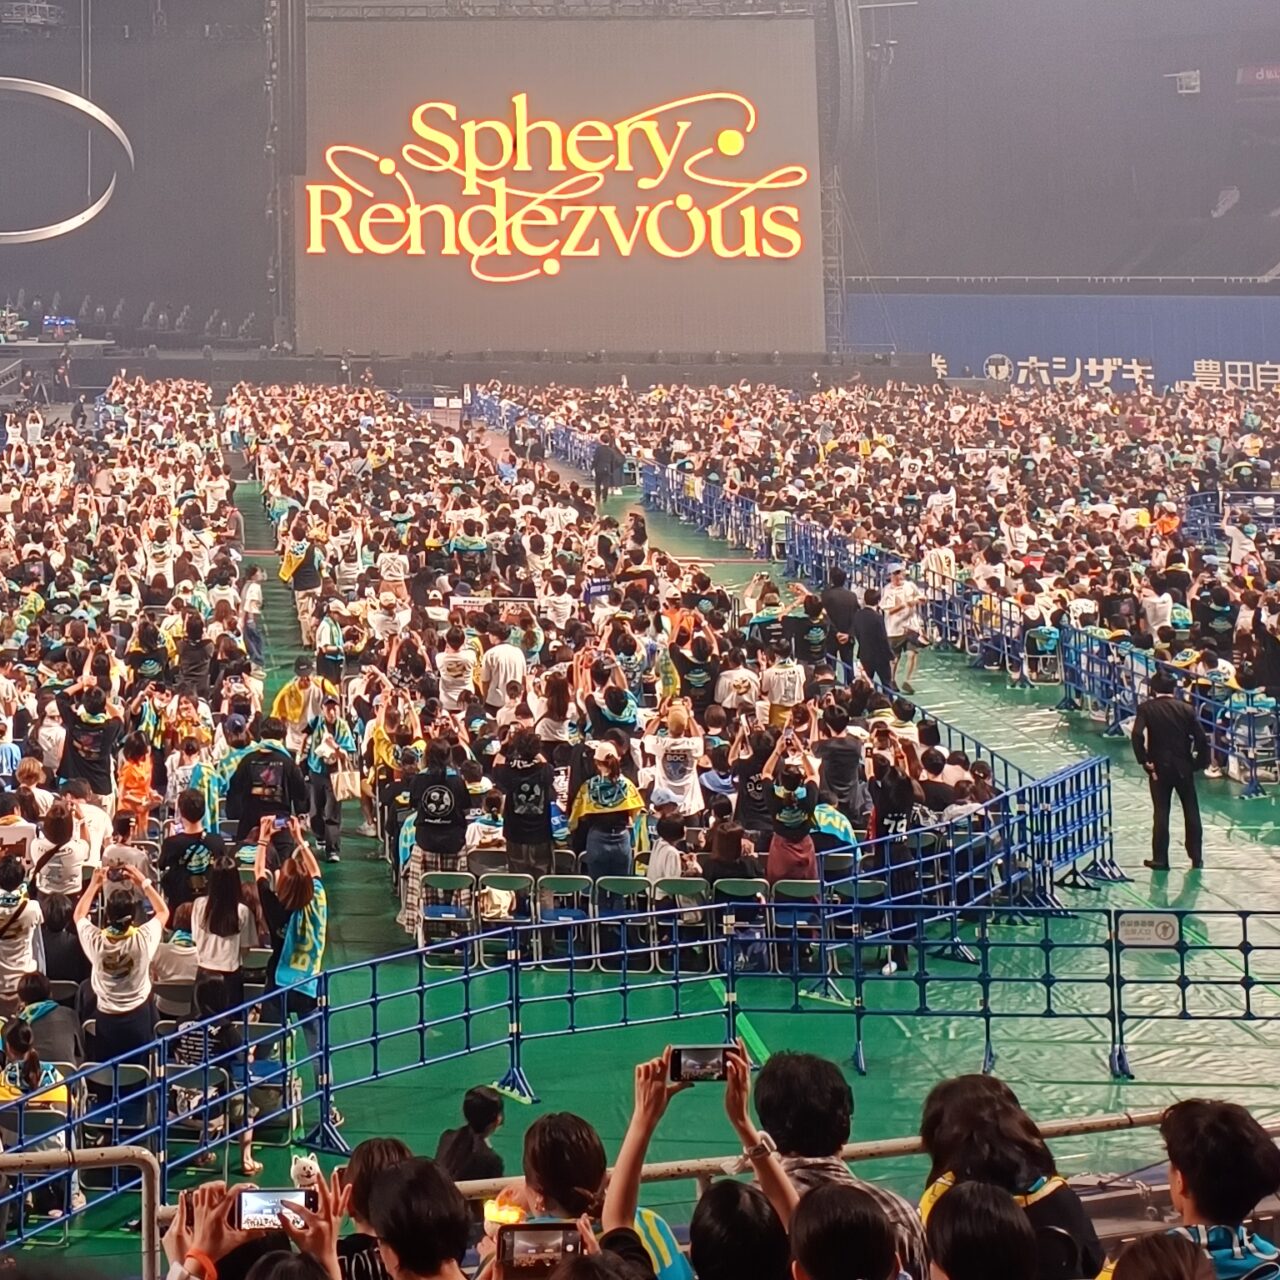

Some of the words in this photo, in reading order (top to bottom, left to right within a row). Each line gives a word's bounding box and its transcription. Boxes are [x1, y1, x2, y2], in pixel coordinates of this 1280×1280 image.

[404, 93, 694, 196] Sphery
[305, 177, 803, 261] Rendezvous
[1017, 356, 1155, 388] ホシザキ
